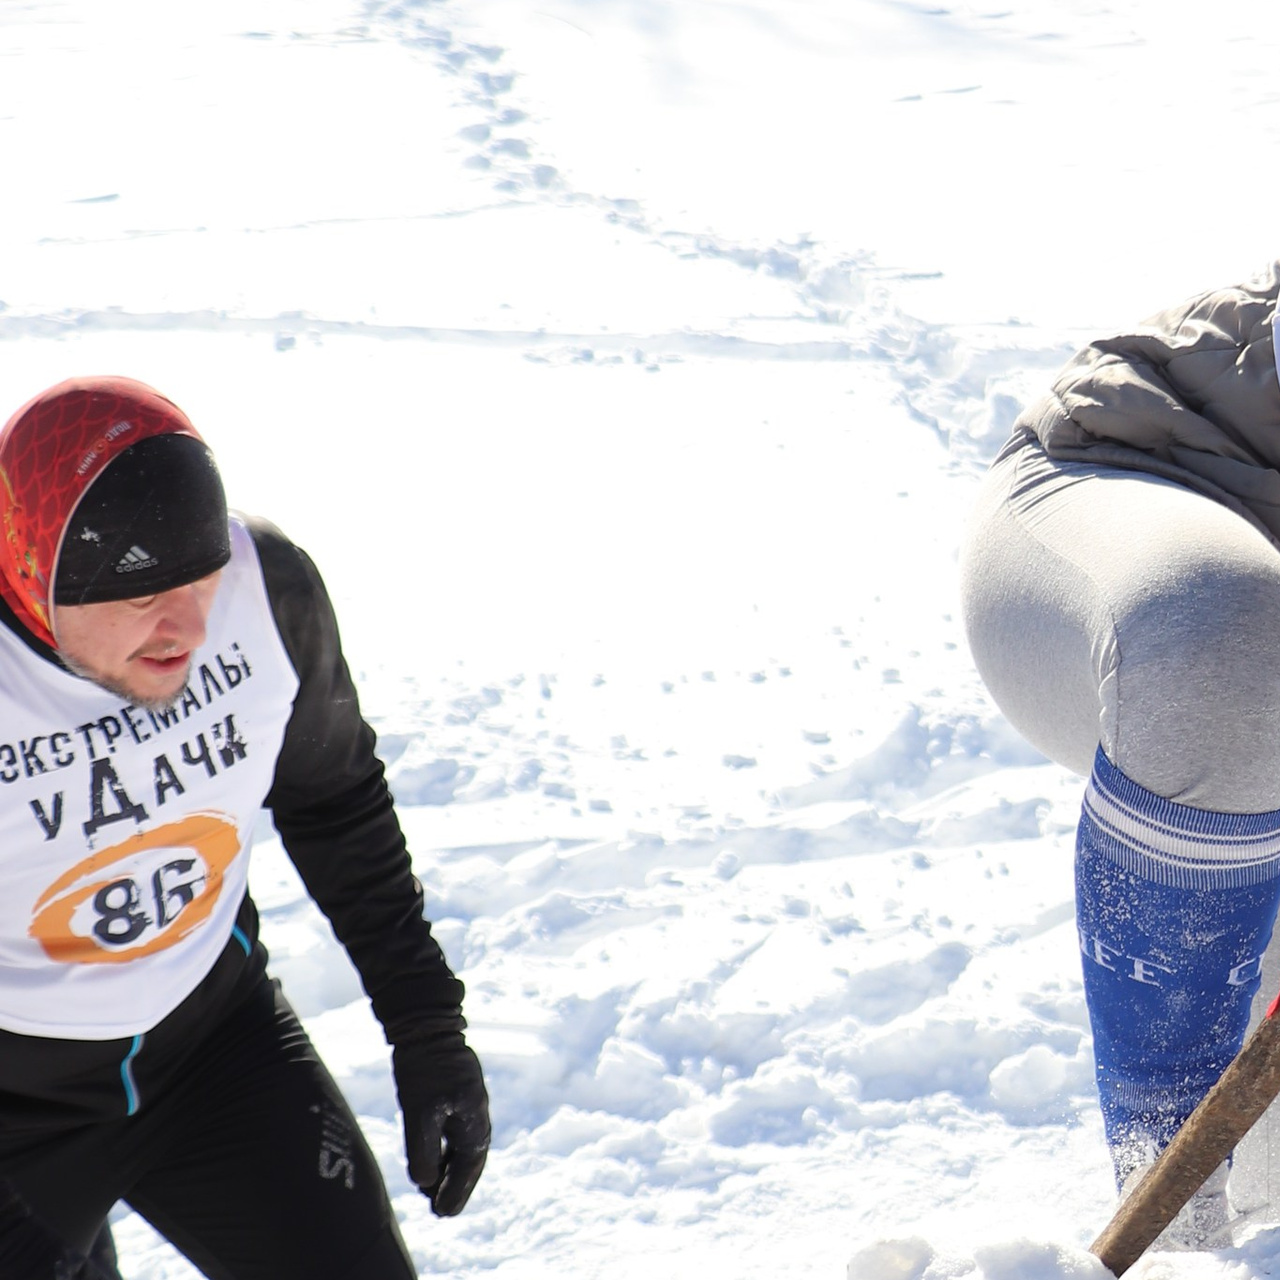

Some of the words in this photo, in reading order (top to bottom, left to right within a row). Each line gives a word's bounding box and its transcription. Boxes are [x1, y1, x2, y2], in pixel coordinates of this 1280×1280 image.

[115, 557, 159, 574] adidas
[28, 714, 249, 844] УДАЧИ
[92, 858, 200, 946] 86
